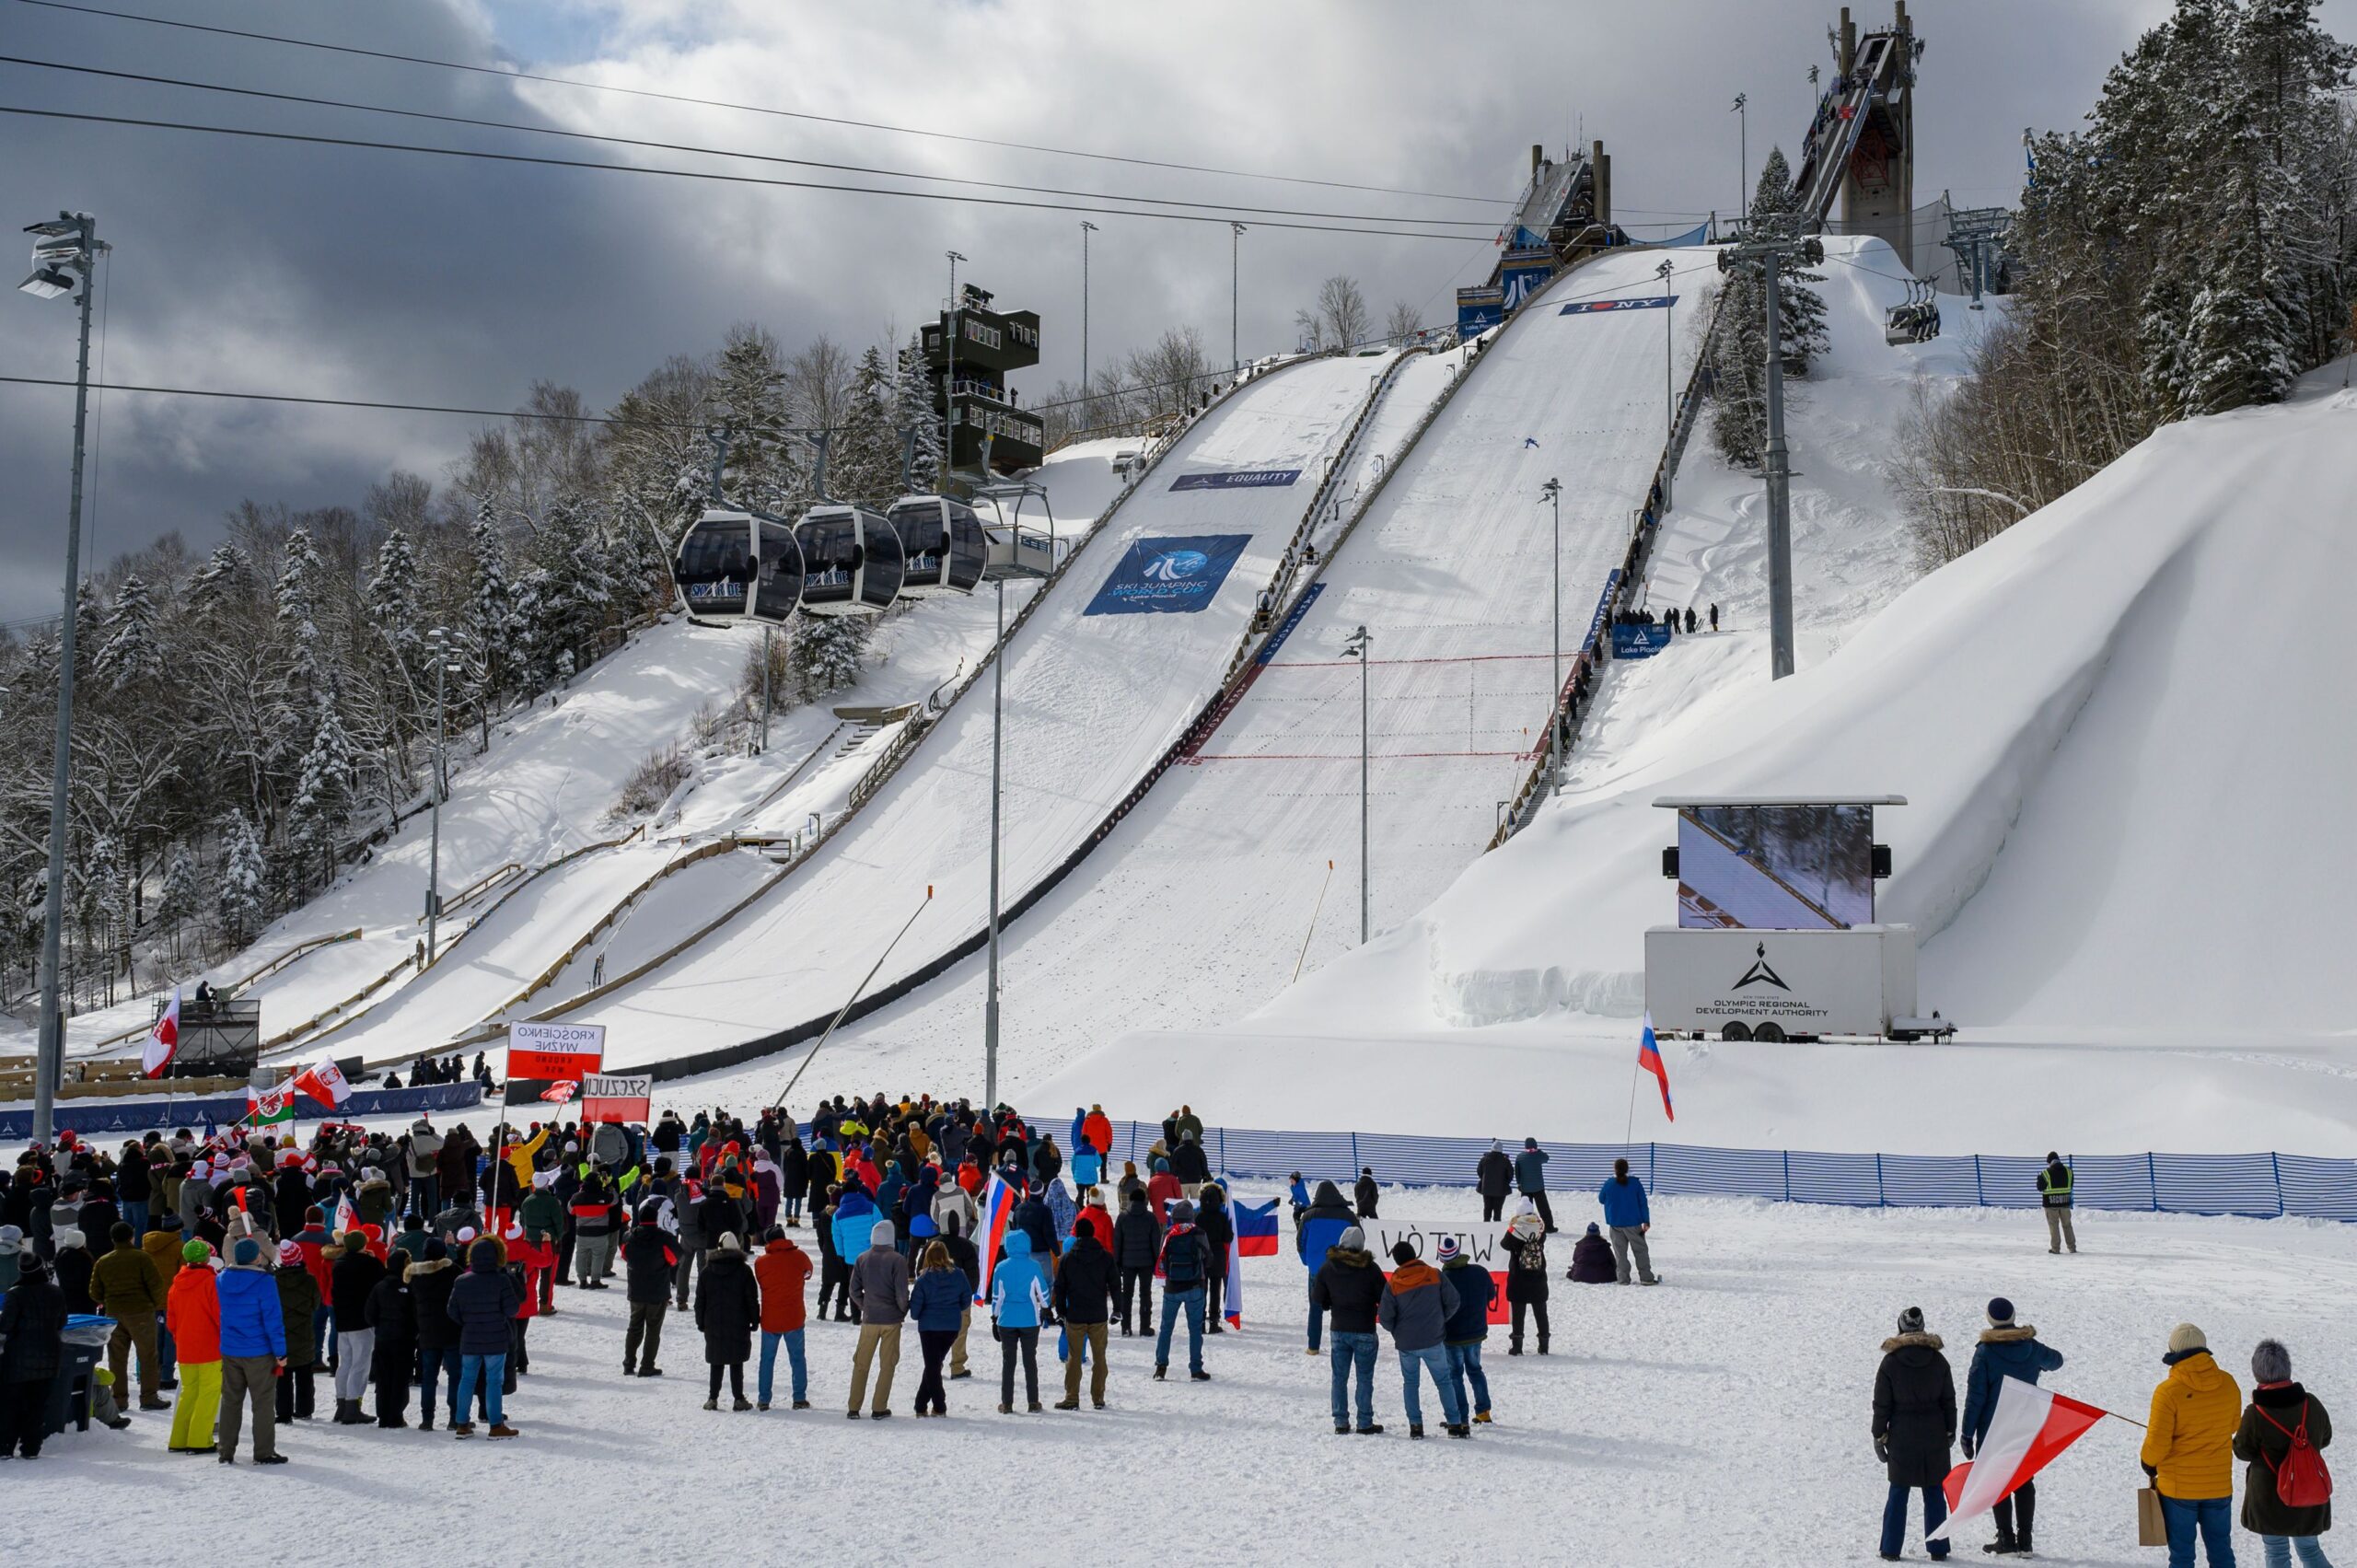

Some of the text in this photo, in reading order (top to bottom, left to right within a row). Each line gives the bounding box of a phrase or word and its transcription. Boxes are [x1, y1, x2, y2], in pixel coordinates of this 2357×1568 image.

[1577, 298, 1661, 312] I NY
[1225, 472, 1291, 483] EQUALITY
[1141, 580, 1208, 589] JUMPING
[1112, 587, 1168, 596] WORLD
[1200, 707, 1229, 738] PLACID
[1173, 757, 1204, 766] HS
[1759, 1000, 1810, 1008] REGIONAL
[1695, 1007, 1829, 1016] DEVELOPMENT AUTHORITY
